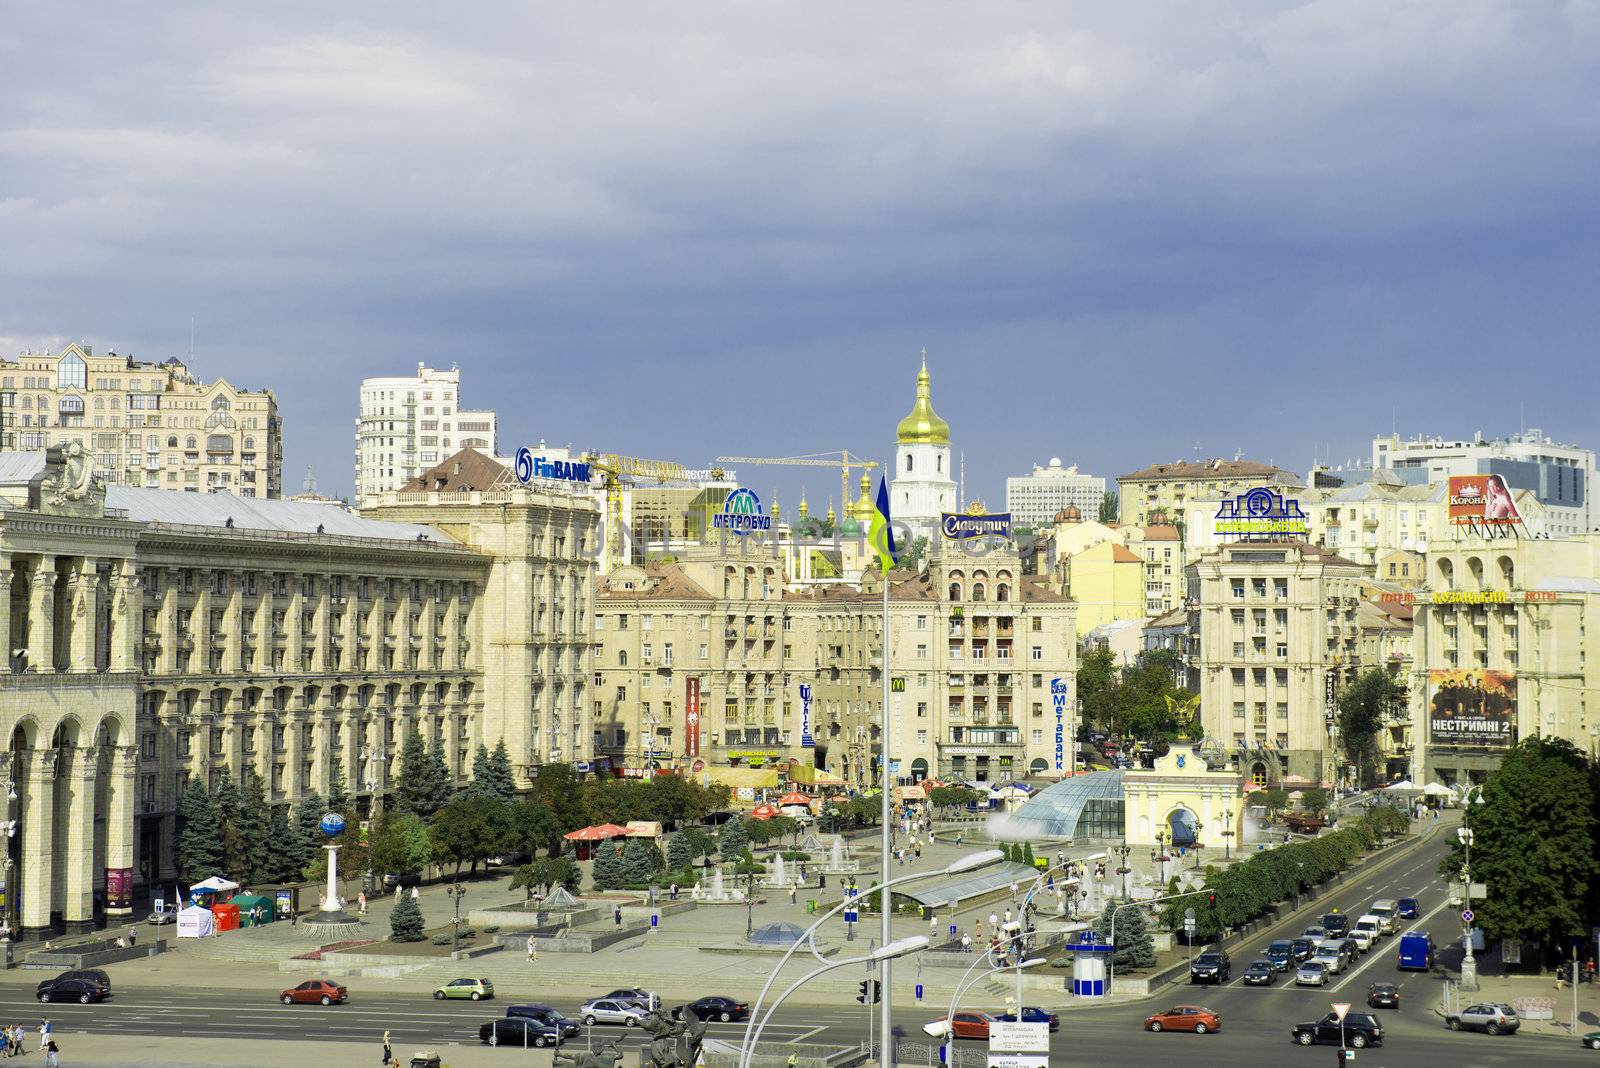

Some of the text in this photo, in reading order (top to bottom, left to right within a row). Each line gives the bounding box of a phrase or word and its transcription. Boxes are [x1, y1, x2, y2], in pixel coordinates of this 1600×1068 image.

[533, 457, 591, 482] FinBANK
[713, 513, 771, 530] МЕТРОБУД
[1432, 719, 1510, 732] НЕСТРИМНІ 2
